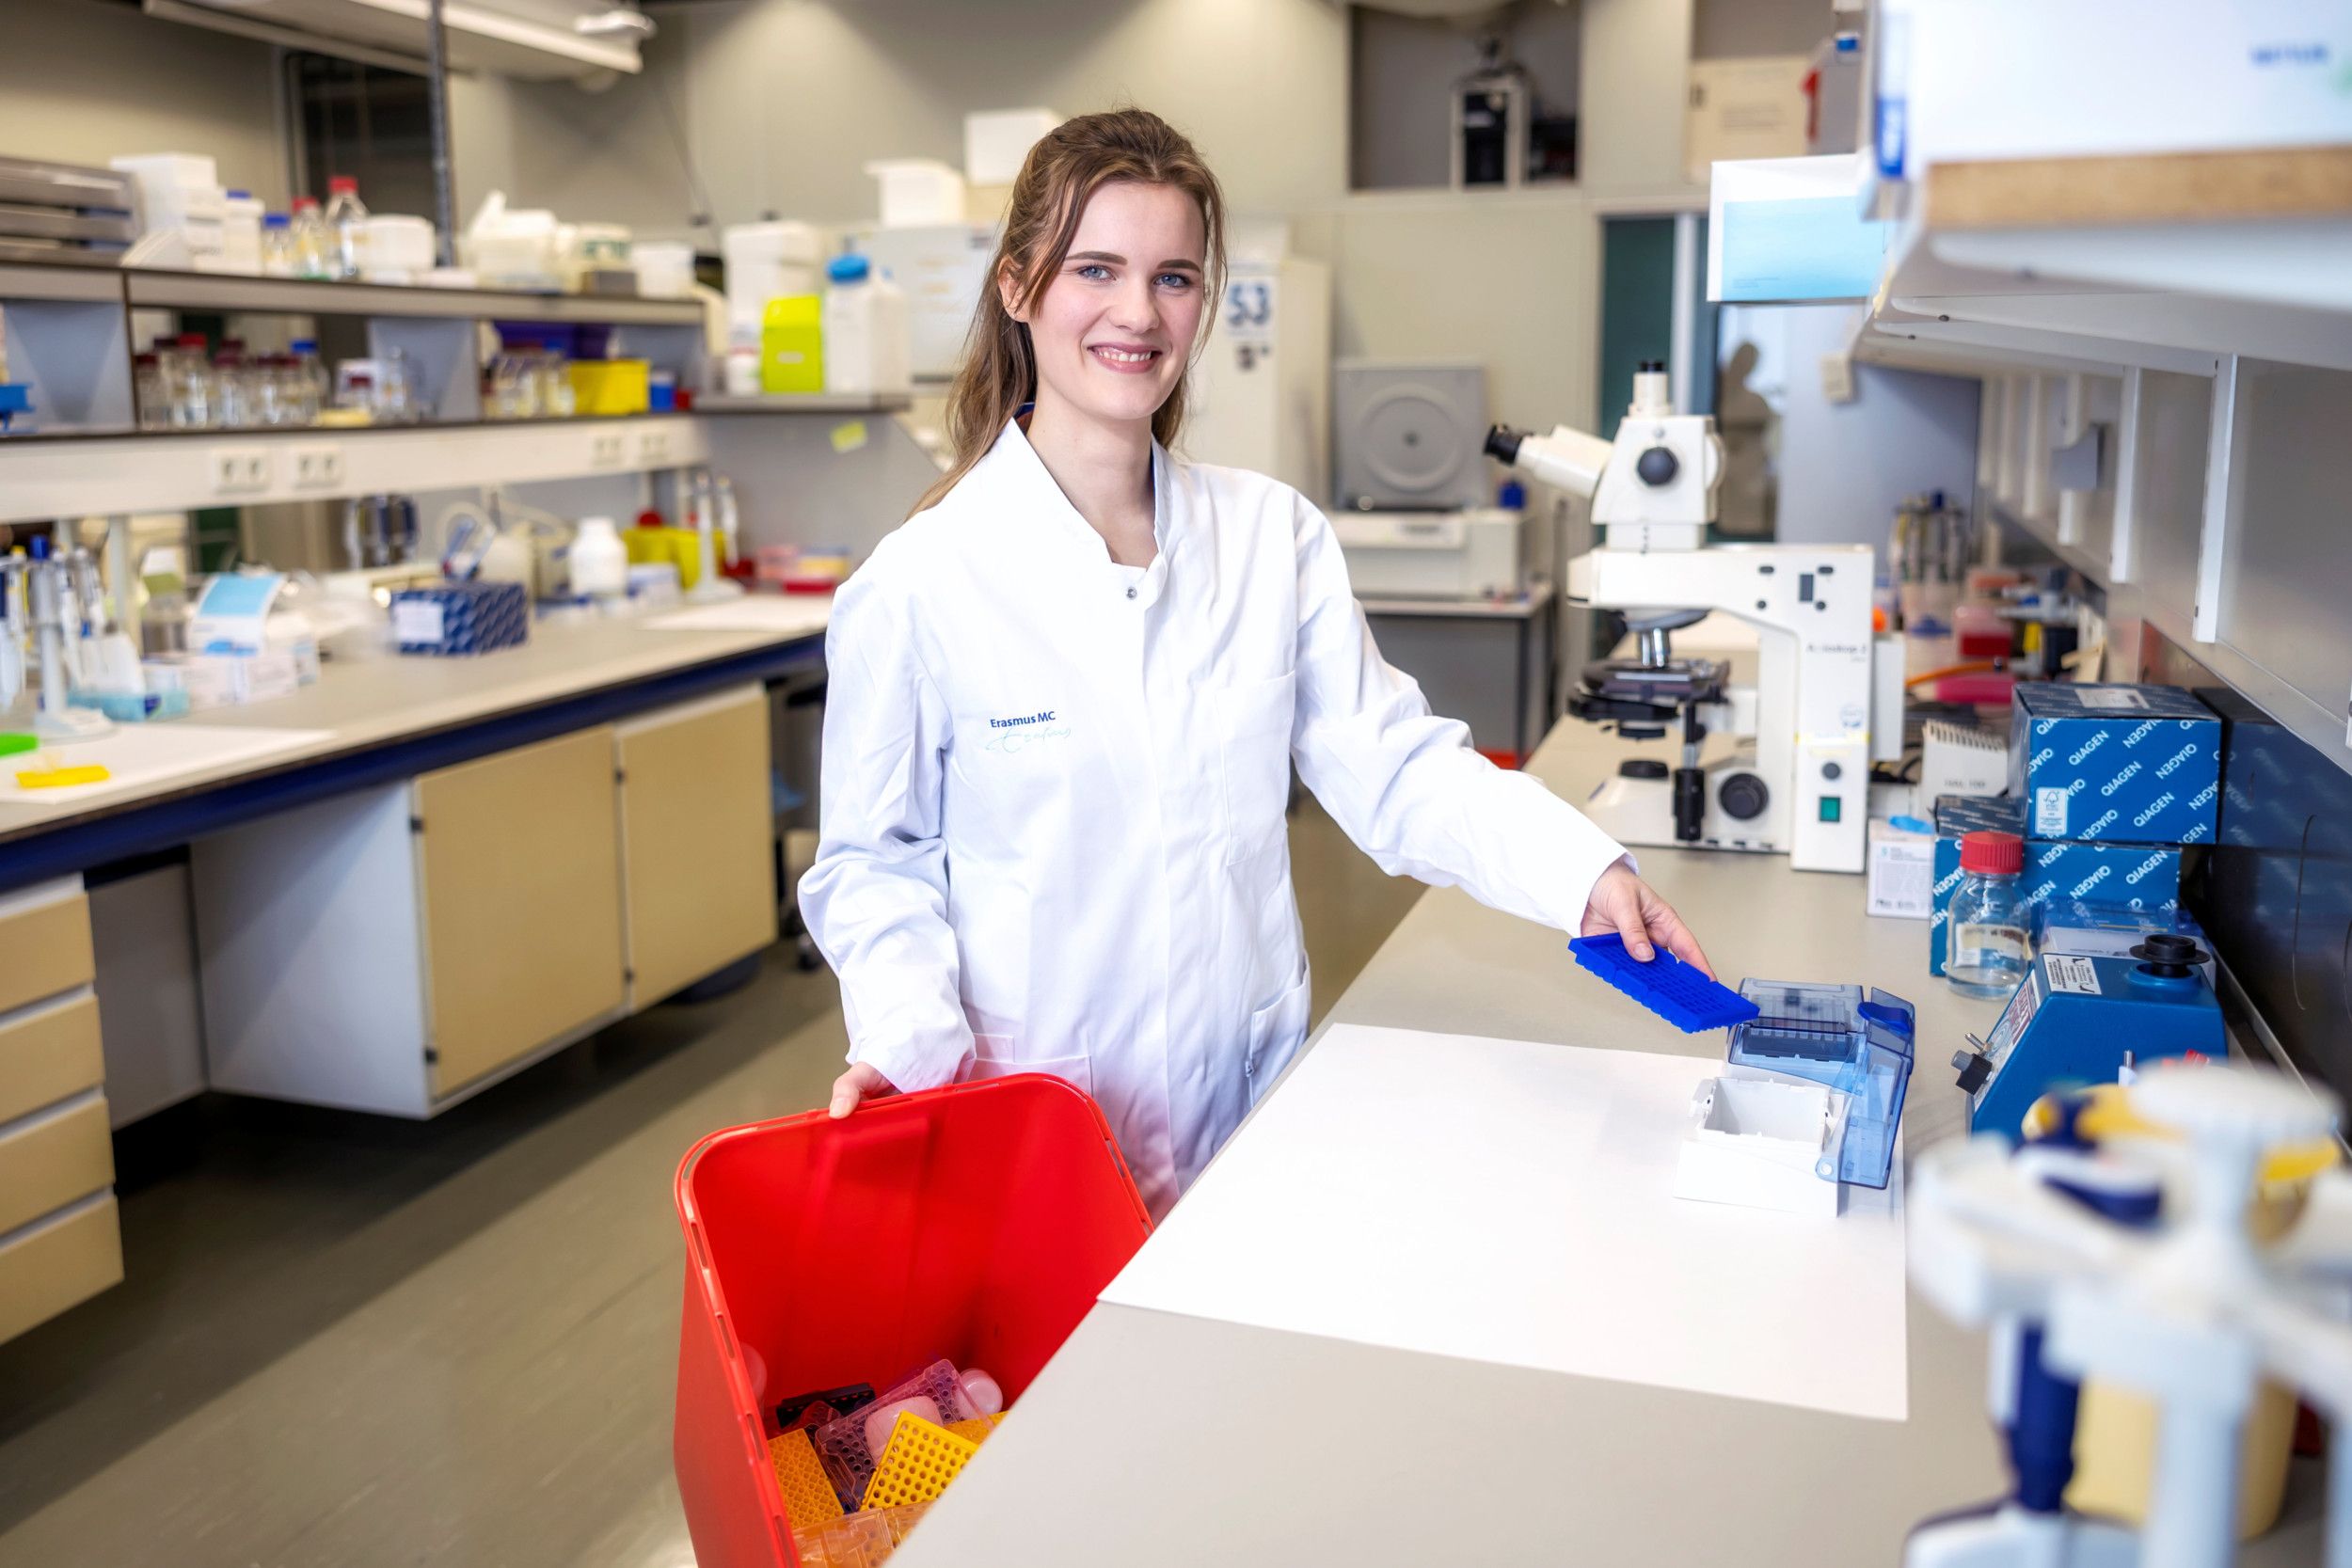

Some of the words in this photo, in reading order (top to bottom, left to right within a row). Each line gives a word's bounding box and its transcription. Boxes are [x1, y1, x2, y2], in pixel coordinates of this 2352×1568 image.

[990, 716, 1036, 728] Erasmus
[1038, 711, 1056, 722] MC
[2068, 730, 2109, 766] QIAGEN
[2155, 743, 2197, 780] QIAGEN
[2101, 761, 2142, 797] QIAGEN
[2187, 781, 2218, 811] AGEN
[2133, 791, 2175, 827] QIAGEN
[2070, 864, 2111, 900] QIAGEN
[2125, 850, 2169, 885] QIAGEN
